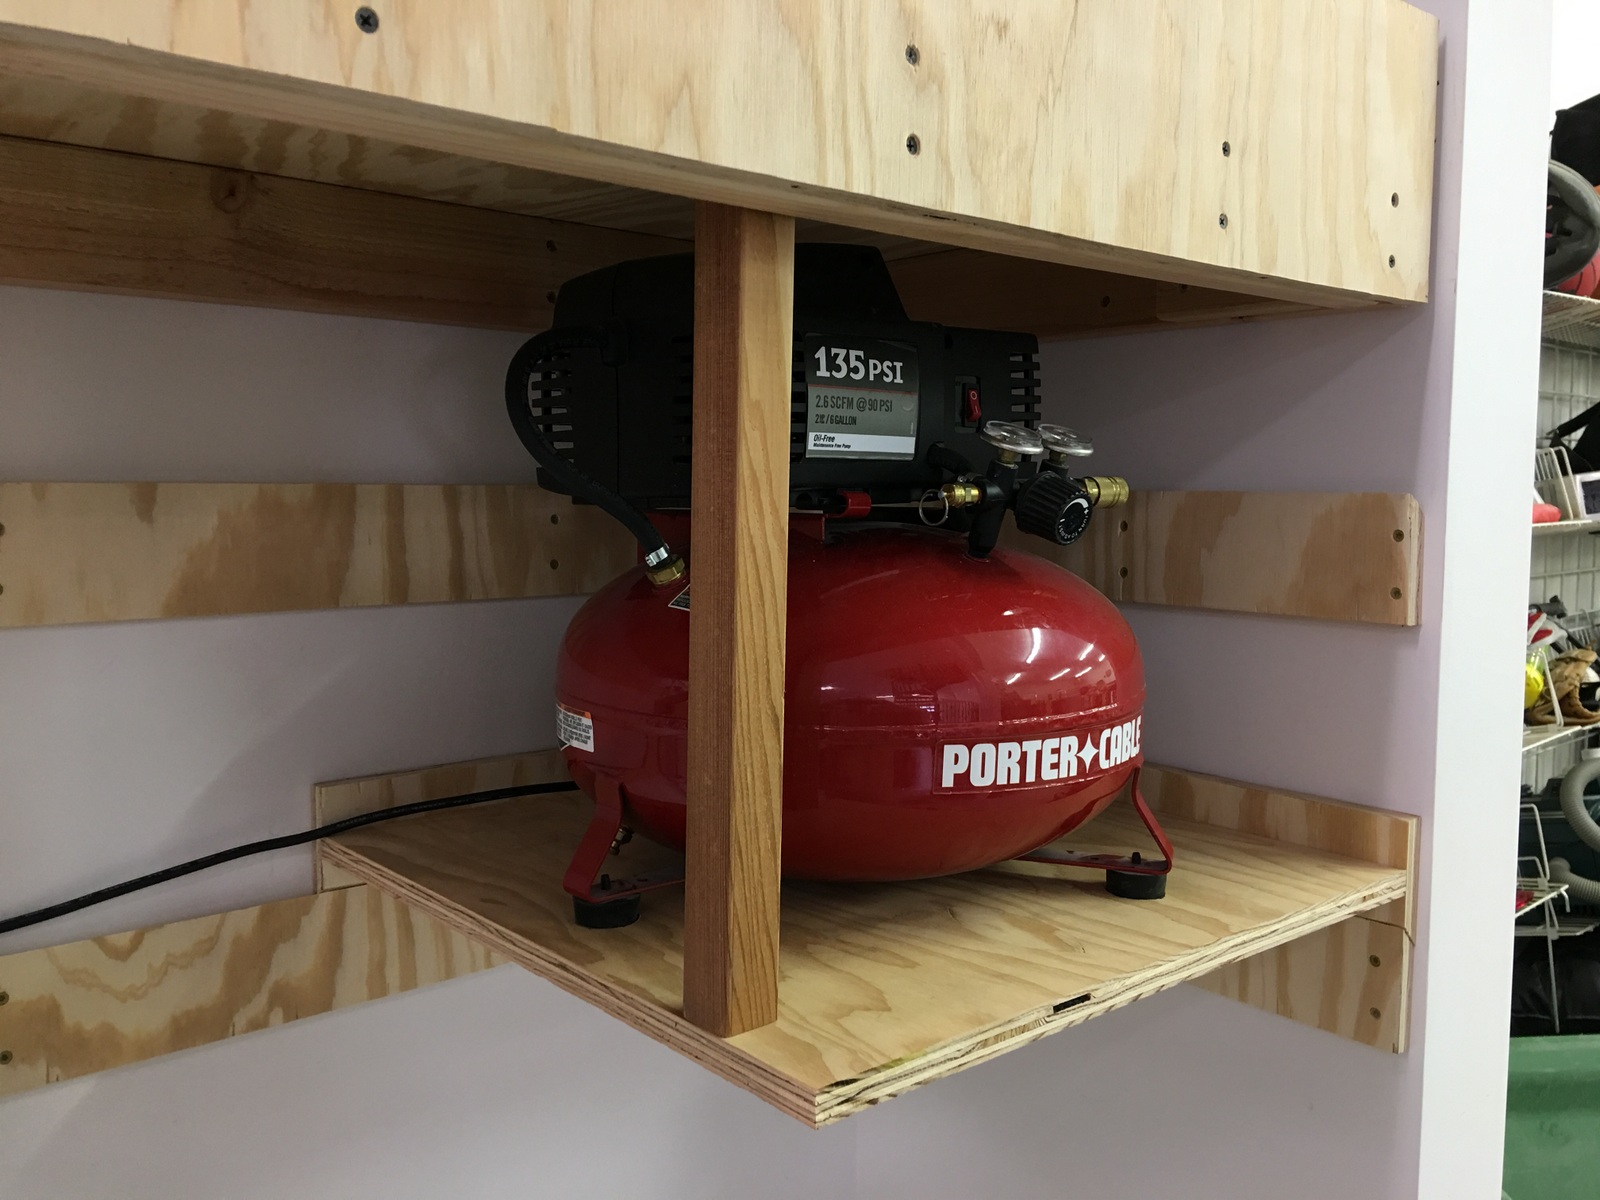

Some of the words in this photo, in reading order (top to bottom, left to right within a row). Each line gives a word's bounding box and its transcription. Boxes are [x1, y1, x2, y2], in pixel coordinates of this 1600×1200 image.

[814, 346, 866, 380] 135
[868, 358, 904, 384] PSI
[815, 394, 829, 408] 2.6
[830, 395, 854, 410] SCFM
[879, 399, 893, 412] PSI
[835, 414, 857, 426] GALLON
[813, 434, 836, 443] Oil-Free
[941, 735, 1079, 788] PORTER
[1099, 715, 1142, 770] CABLE
